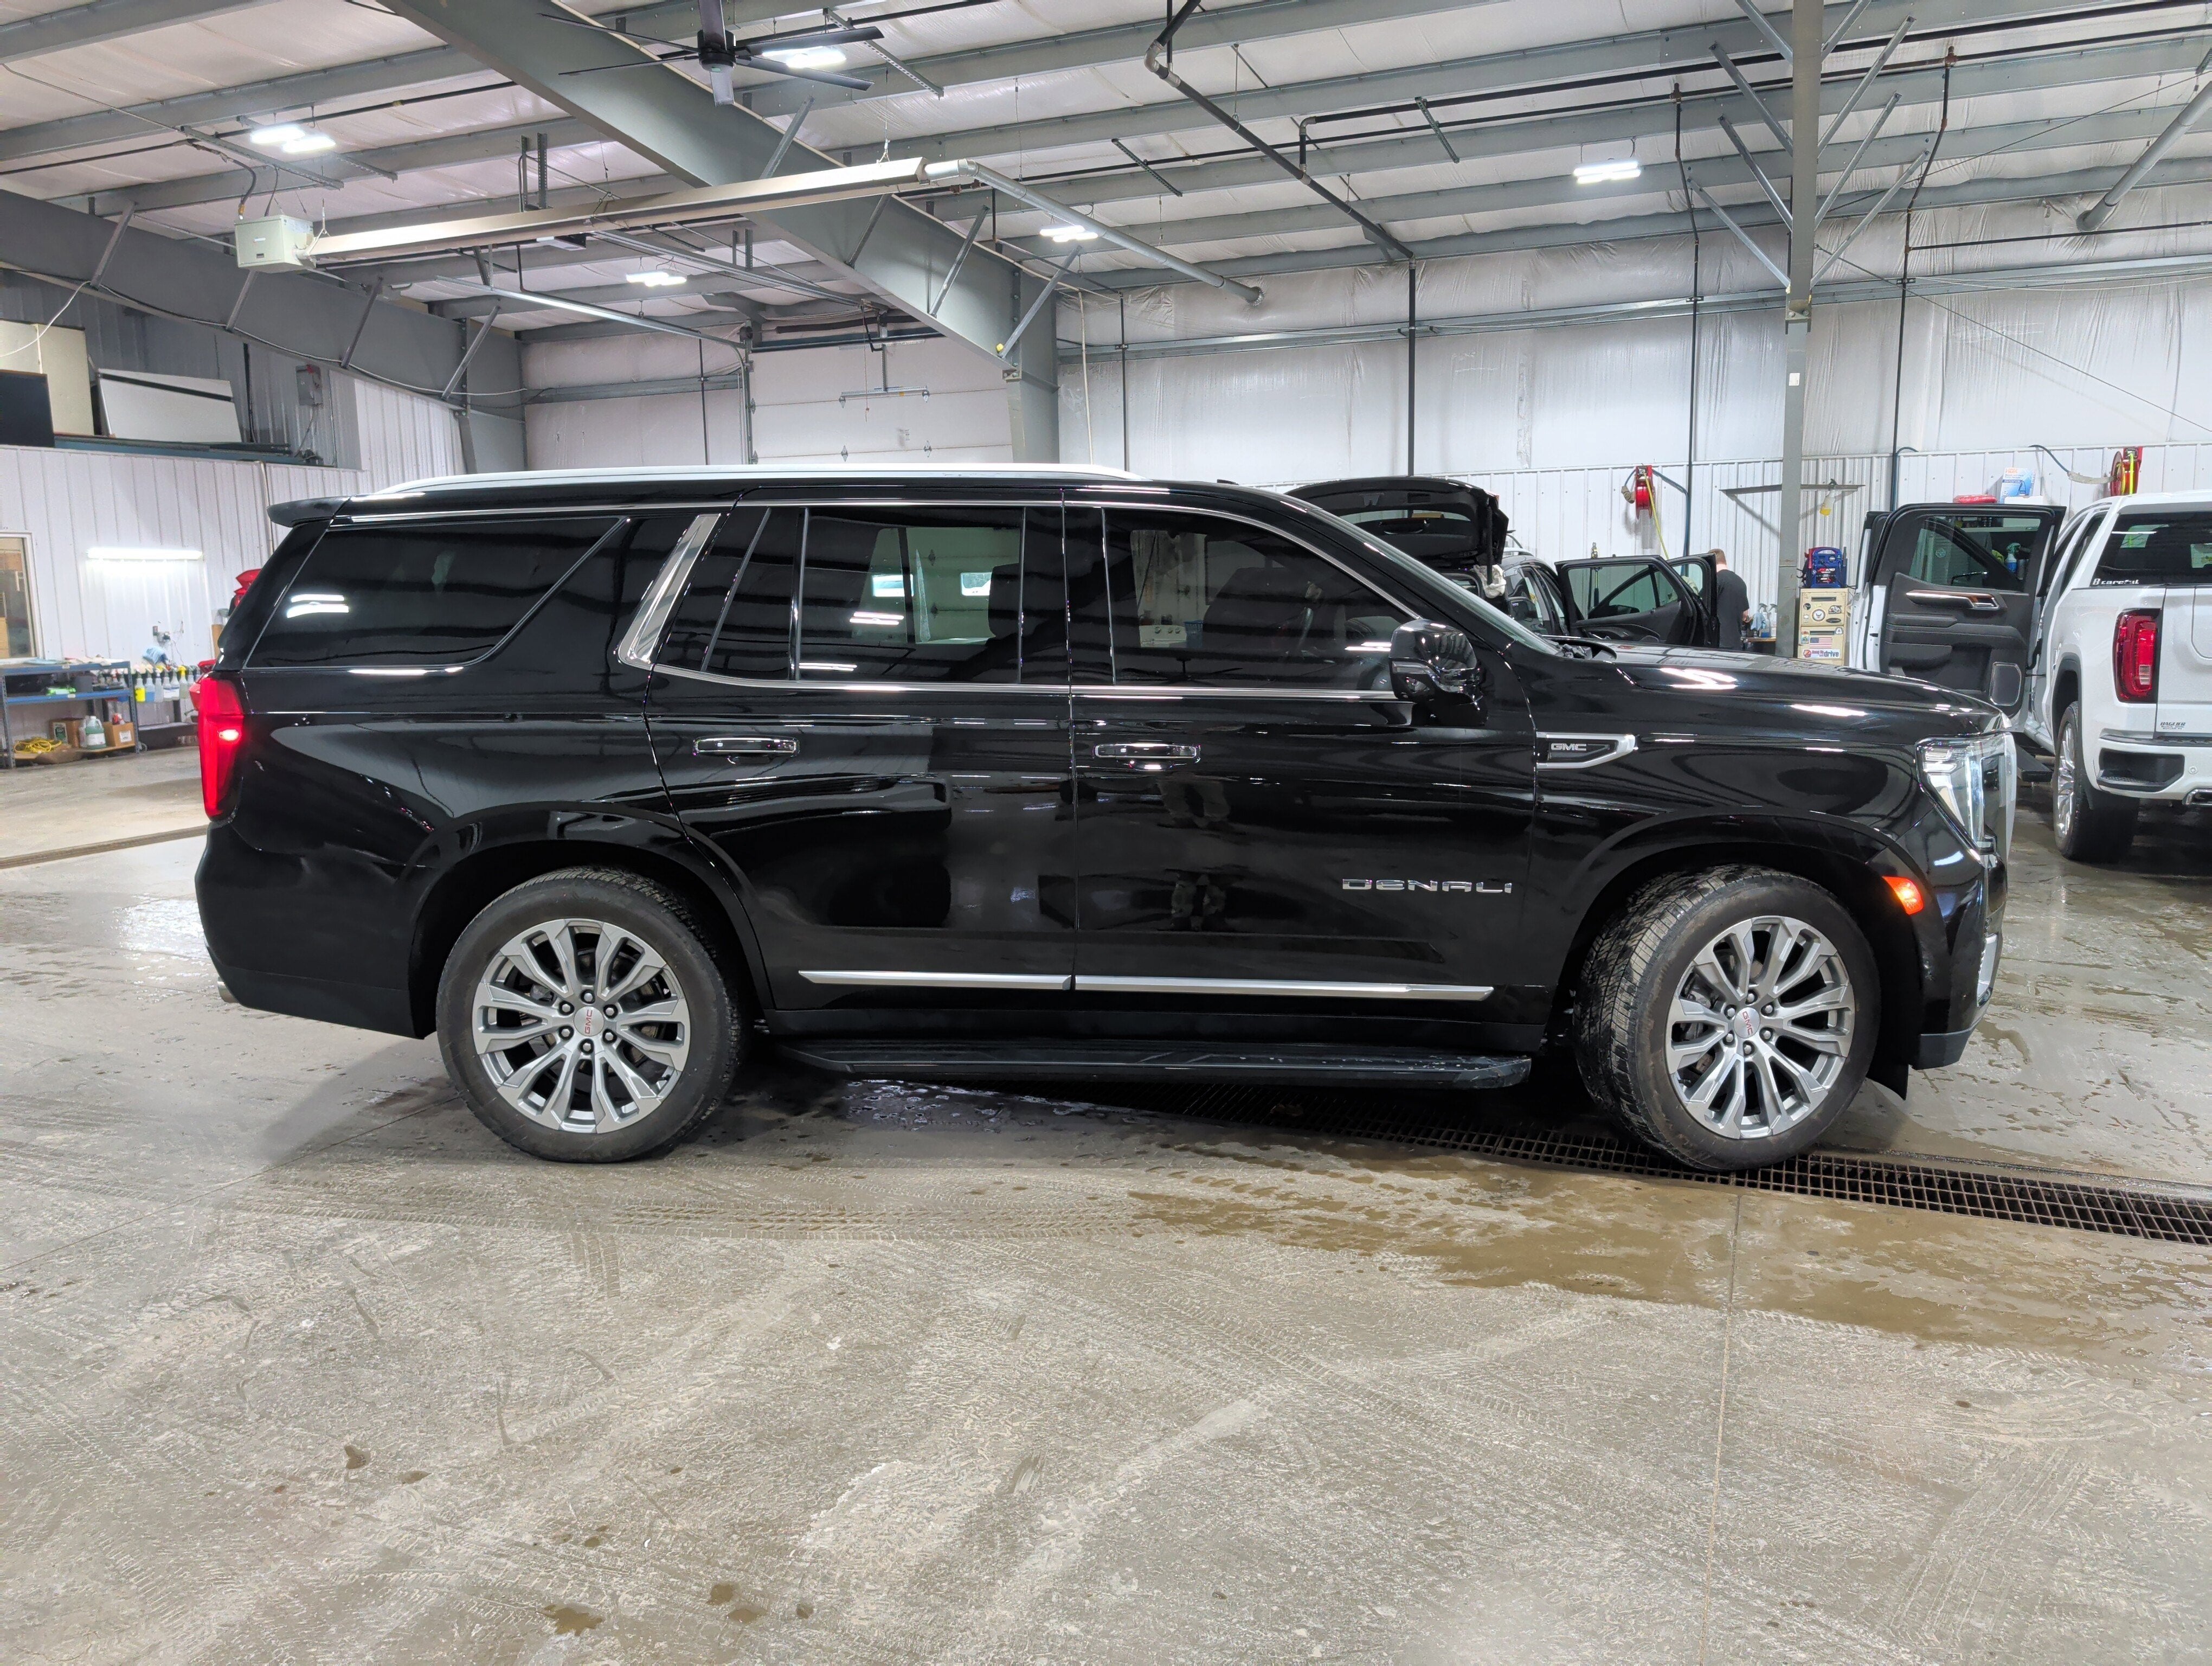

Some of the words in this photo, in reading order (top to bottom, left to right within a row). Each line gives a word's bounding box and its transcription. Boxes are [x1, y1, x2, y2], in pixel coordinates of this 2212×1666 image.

[1342, 879, 1512, 893] DENALI
[584, 1009, 593, 1034] GMC
[1742, 1011, 1753, 1035] GMC
